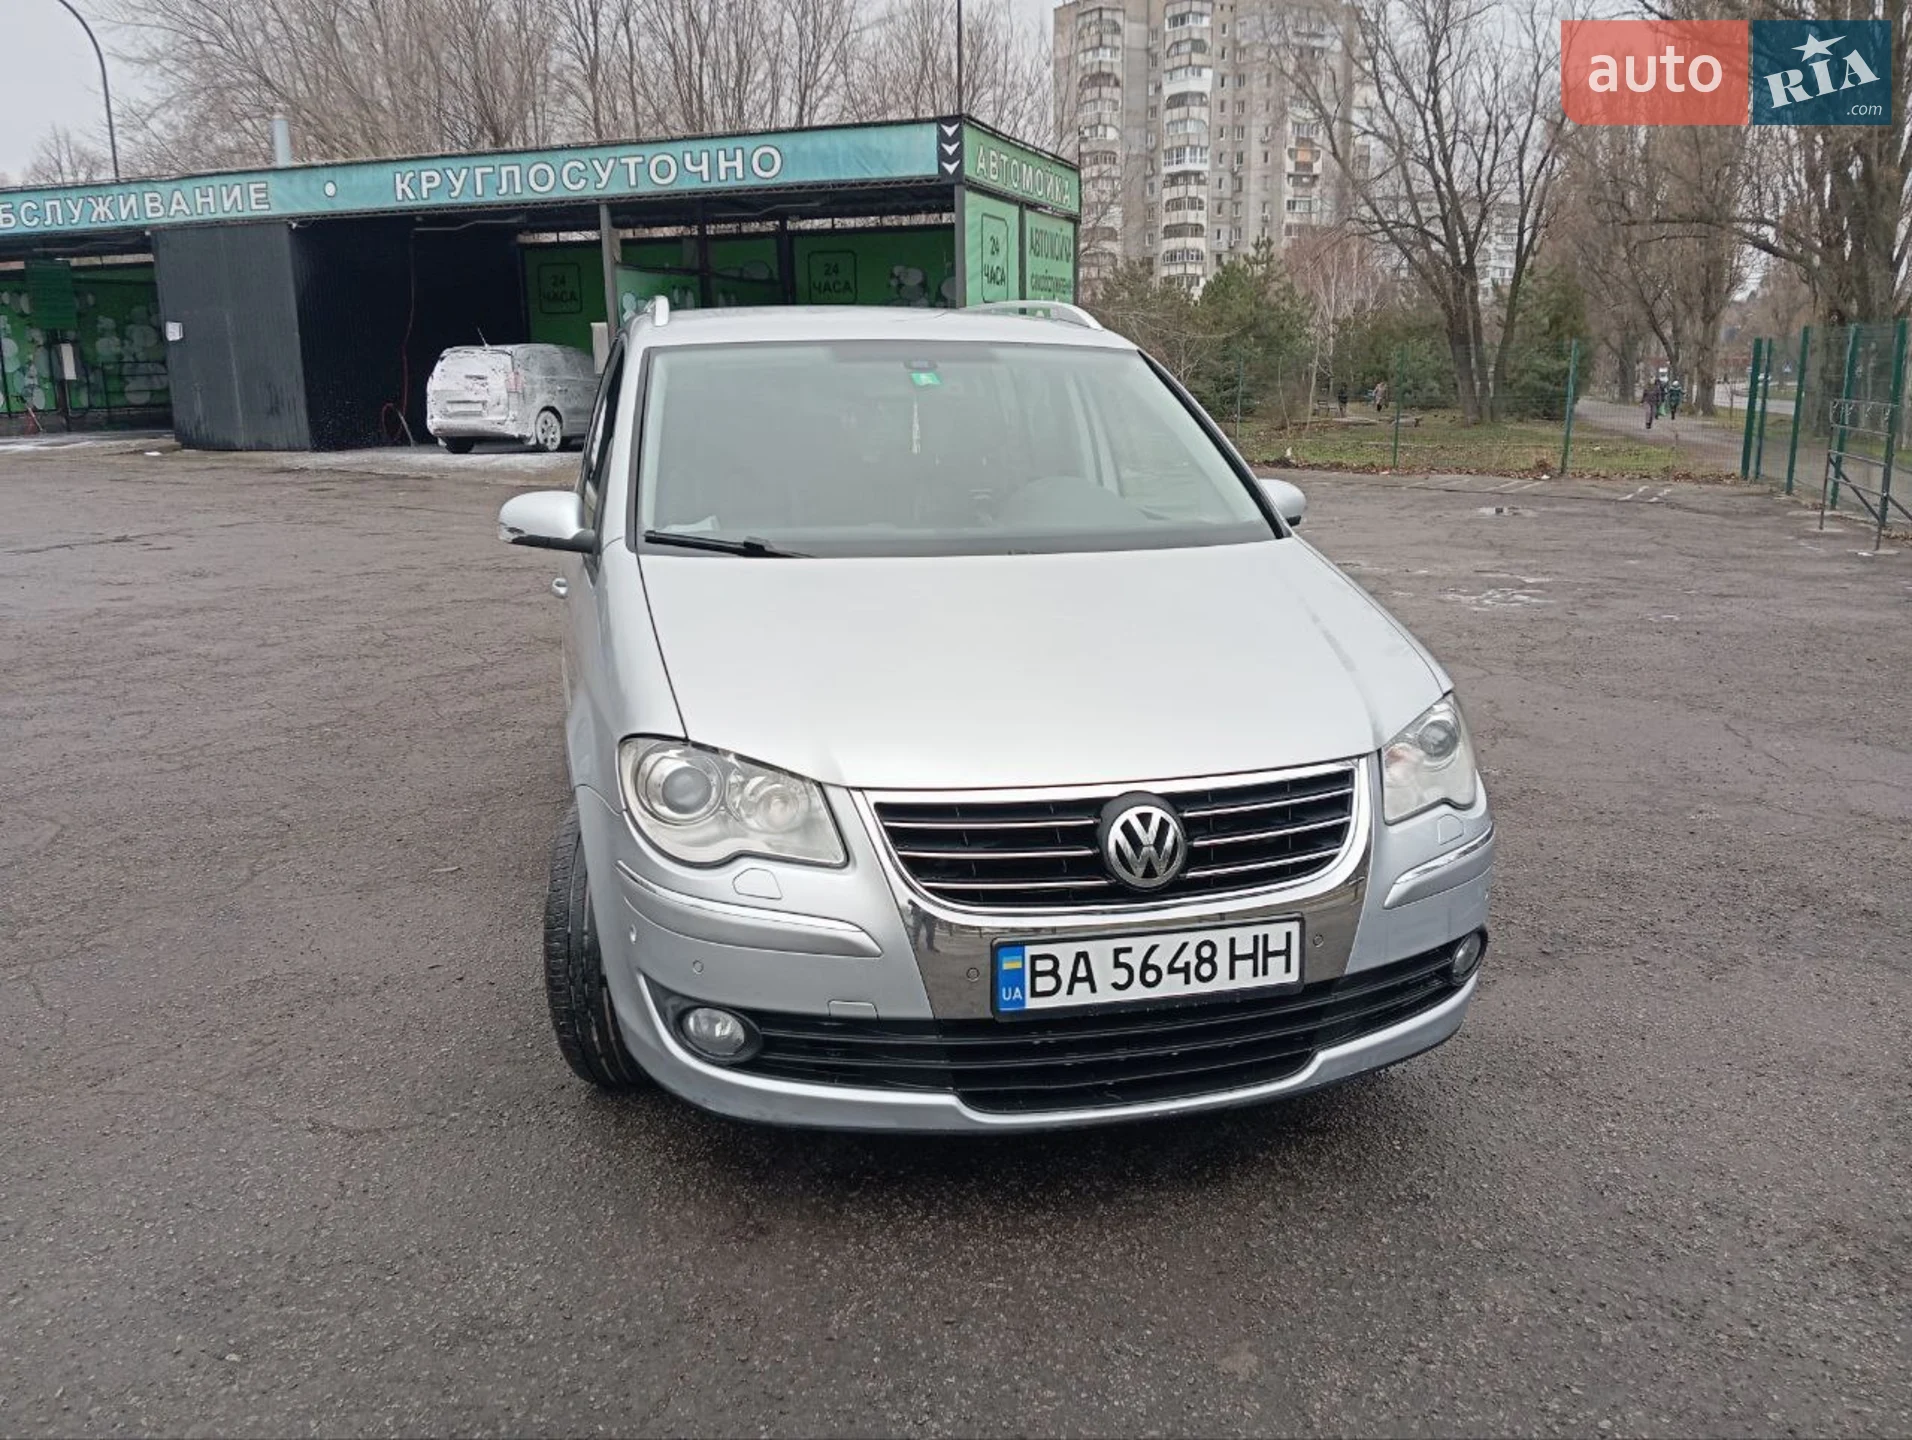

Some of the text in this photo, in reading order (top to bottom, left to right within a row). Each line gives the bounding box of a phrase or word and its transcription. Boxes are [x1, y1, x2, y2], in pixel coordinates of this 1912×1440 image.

[394, 144, 783, 202] КРУГЛОСУТОЧНО
[975, 145, 1072, 208] АВТОМОЙКА
[989, 235, 1000, 256] 24
[823, 262, 839, 276] 24
[983, 265, 1006, 287] ЧАСА
[812, 279, 853, 295] ЧАСА
[1107, 805, 1184, 888] VW
[1111, 939, 1218, 991] 5648
[1002, 986, 1023, 1001] UA
